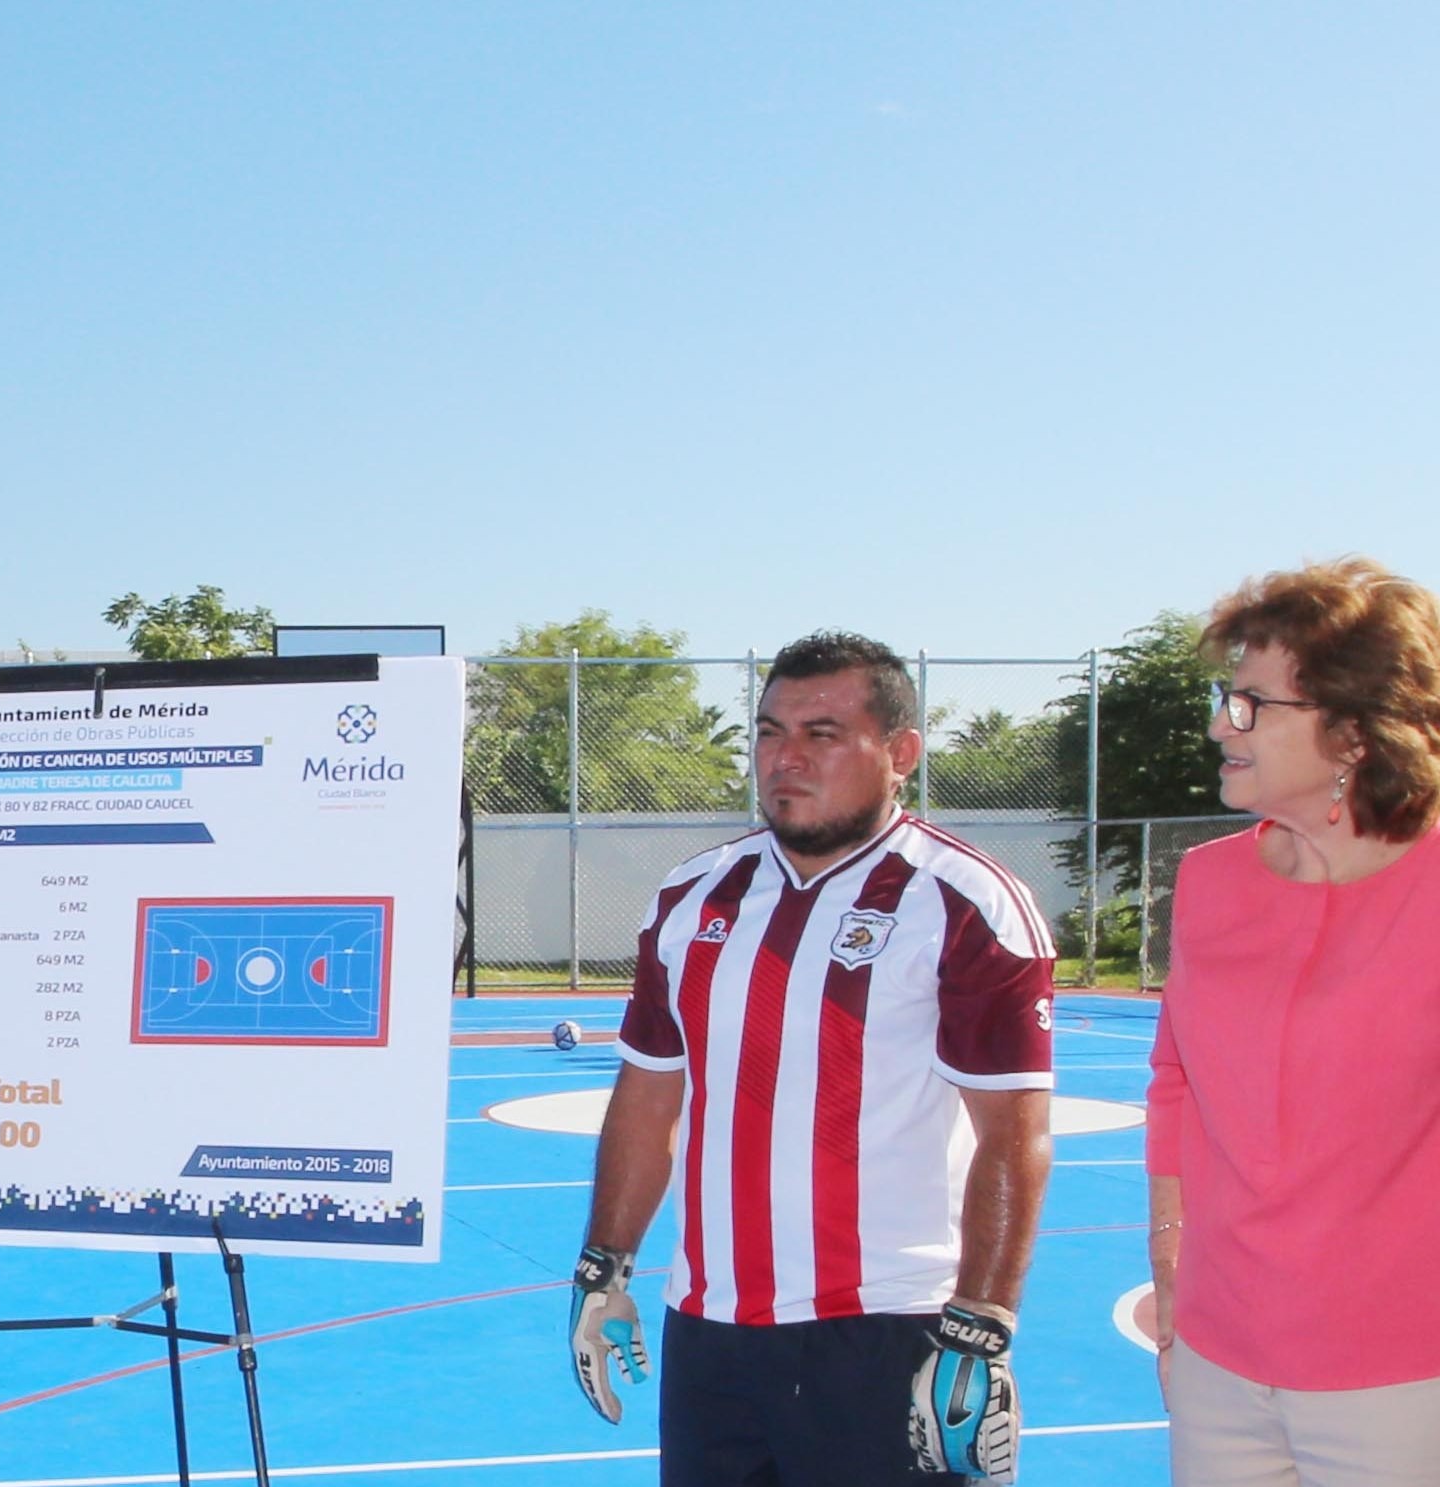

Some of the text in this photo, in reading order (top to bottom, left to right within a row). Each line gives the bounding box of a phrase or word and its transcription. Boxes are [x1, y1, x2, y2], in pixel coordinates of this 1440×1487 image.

[109, 704, 133, 719] de
[139, 703, 209, 718] Mérida
[54, 728, 72, 742] de
[76, 727, 123, 741] Obras
[128, 725, 195, 740] Públicas
[23, 755, 42, 768] DE
[45, 754, 103, 767] CANCHA
[106, 752, 125, 765] DE
[128, 751, 167, 765] USOS
[170, 748, 253, 764] MÚLTIPLES
[302, 755, 405, 782] Mérida
[41, 776, 91, 789] TERESA
[91, 776, 110, 788] DE
[112, 774, 173, 787] CALCUTA
[4, 801, 20, 812] 80
[23, 801, 31, 811] Y
[32, 801, 49, 811] 82
[95, 799, 143, 810] CIUDAD
[145, 798, 194, 810] CAUCEL
[41, 876, 66, 887] 649
[68, 875, 89, 887] M2
[59, 902, 67, 913] 6
[68, 902, 88, 912] M2
[53, 930, 61, 941] 2
[63, 930, 86, 941] PZA
[36, 955, 62, 966] 649
[64, 954, 85, 966] M2
[35, 982, 61, 993] 282
[63, 982, 84, 993] M2
[44, 1011, 53, 1022] 8
[56, 1011, 81, 1022] PZA
[47, 1037, 55, 1048] 2
[56, 1037, 80, 1048] PZA
[198, 1153, 303, 1172] Ayuntamiento
[304, 1156, 340, 1173] 2015
[352, 1157, 390, 1174] 2018
